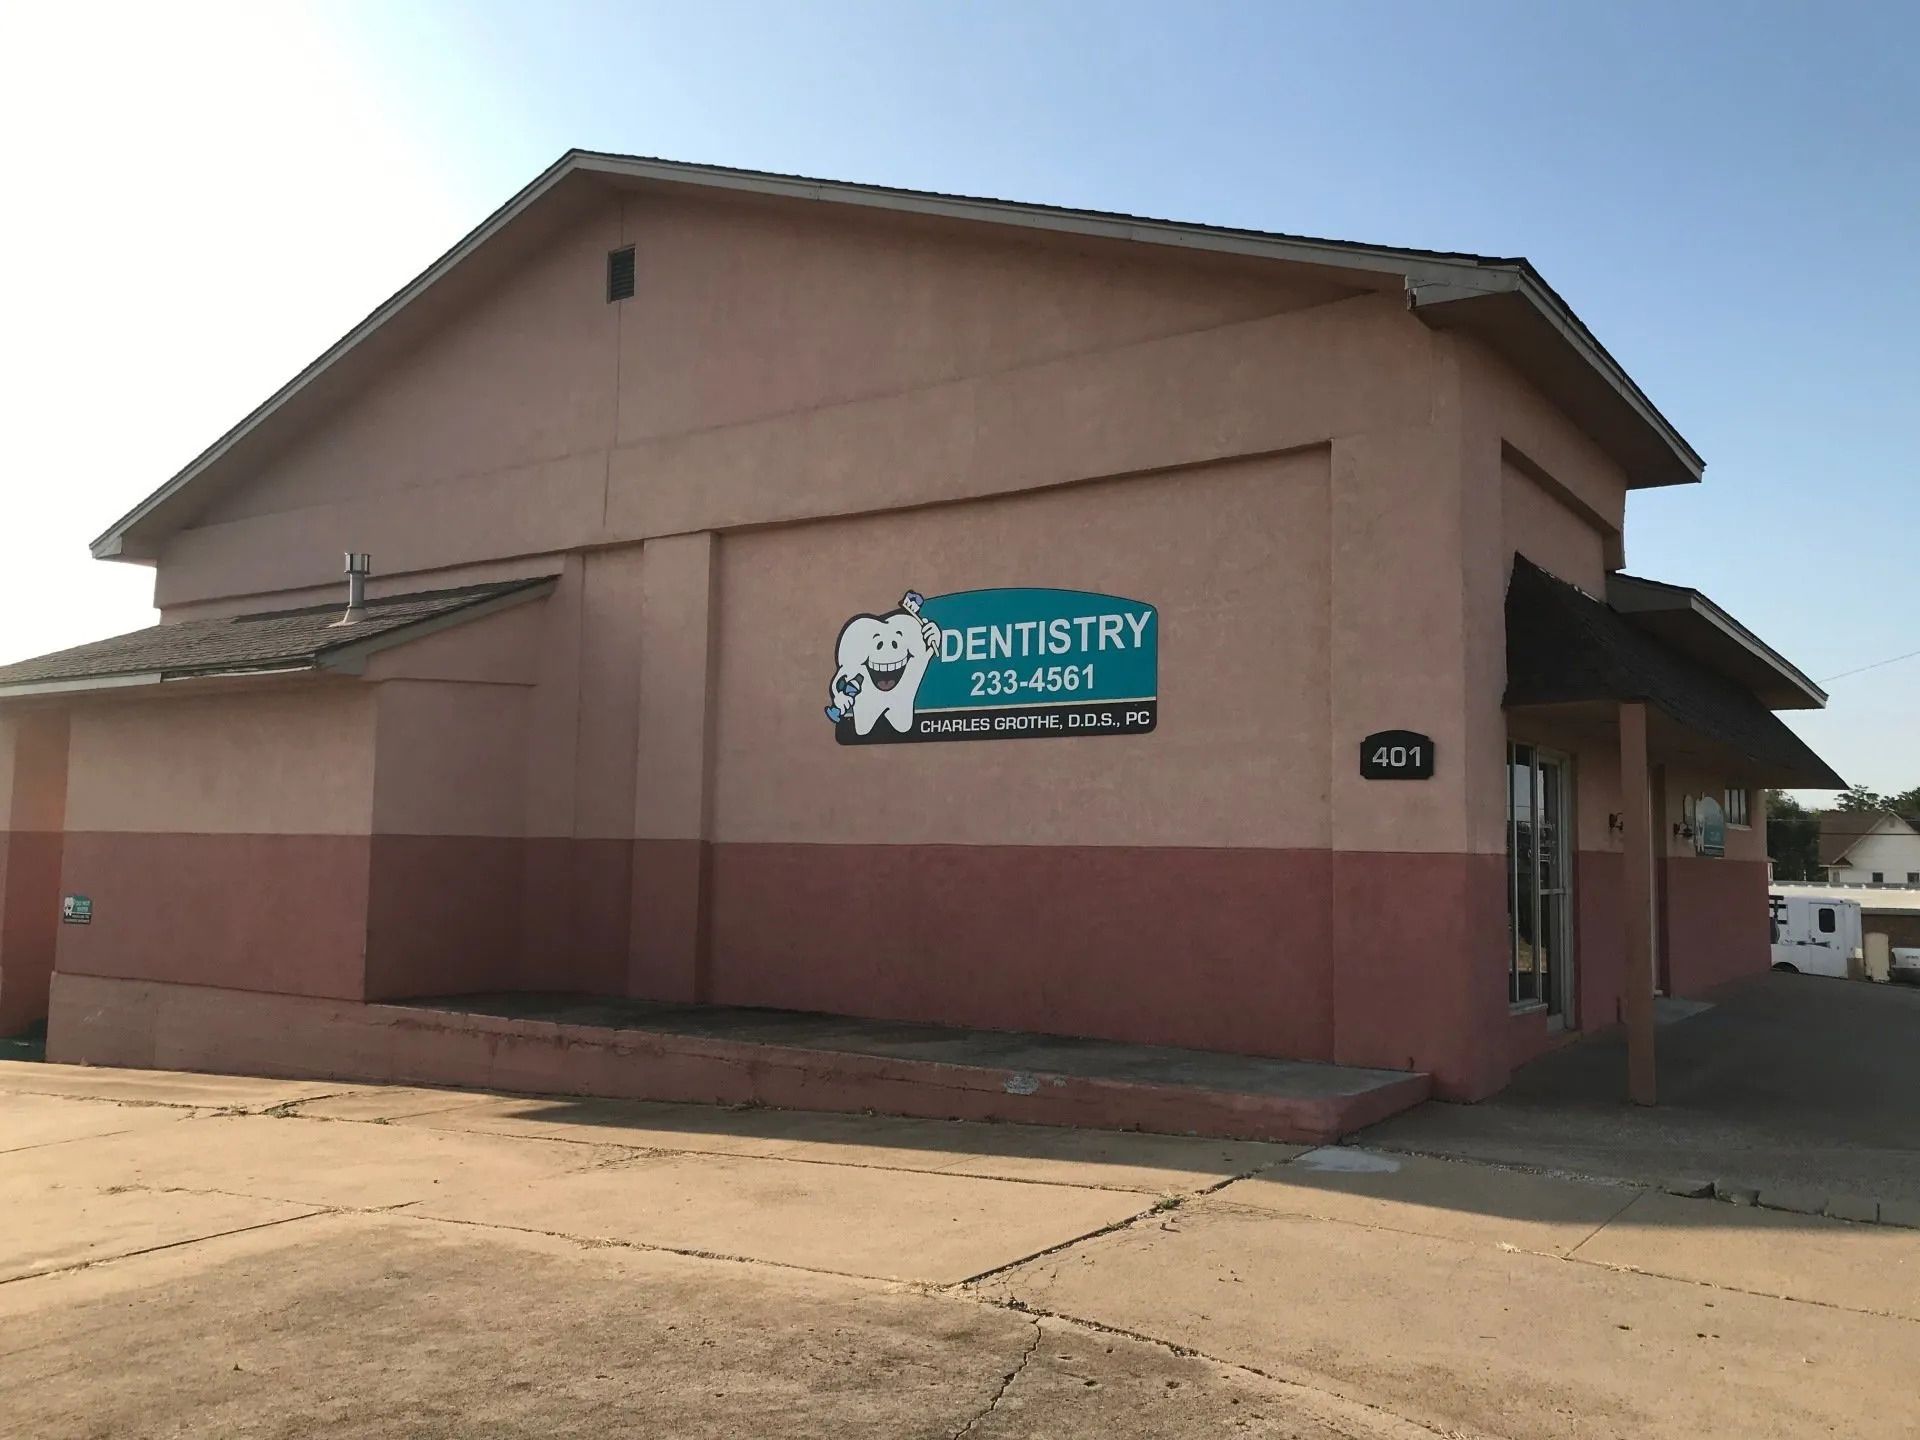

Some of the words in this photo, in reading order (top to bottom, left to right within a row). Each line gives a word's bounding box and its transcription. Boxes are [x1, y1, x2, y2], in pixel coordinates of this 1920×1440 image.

[941, 611, 1152, 663] DENTISTRY
[970, 664, 1094, 696] 233-4561
[920, 718, 990, 733] CHARLES
[994, 715, 1063, 731] GROTHE,
[1069, 713, 1120, 729] D.D.S.,
[1125, 711, 1150, 726] PC
[1372, 746, 1421, 767] 401
